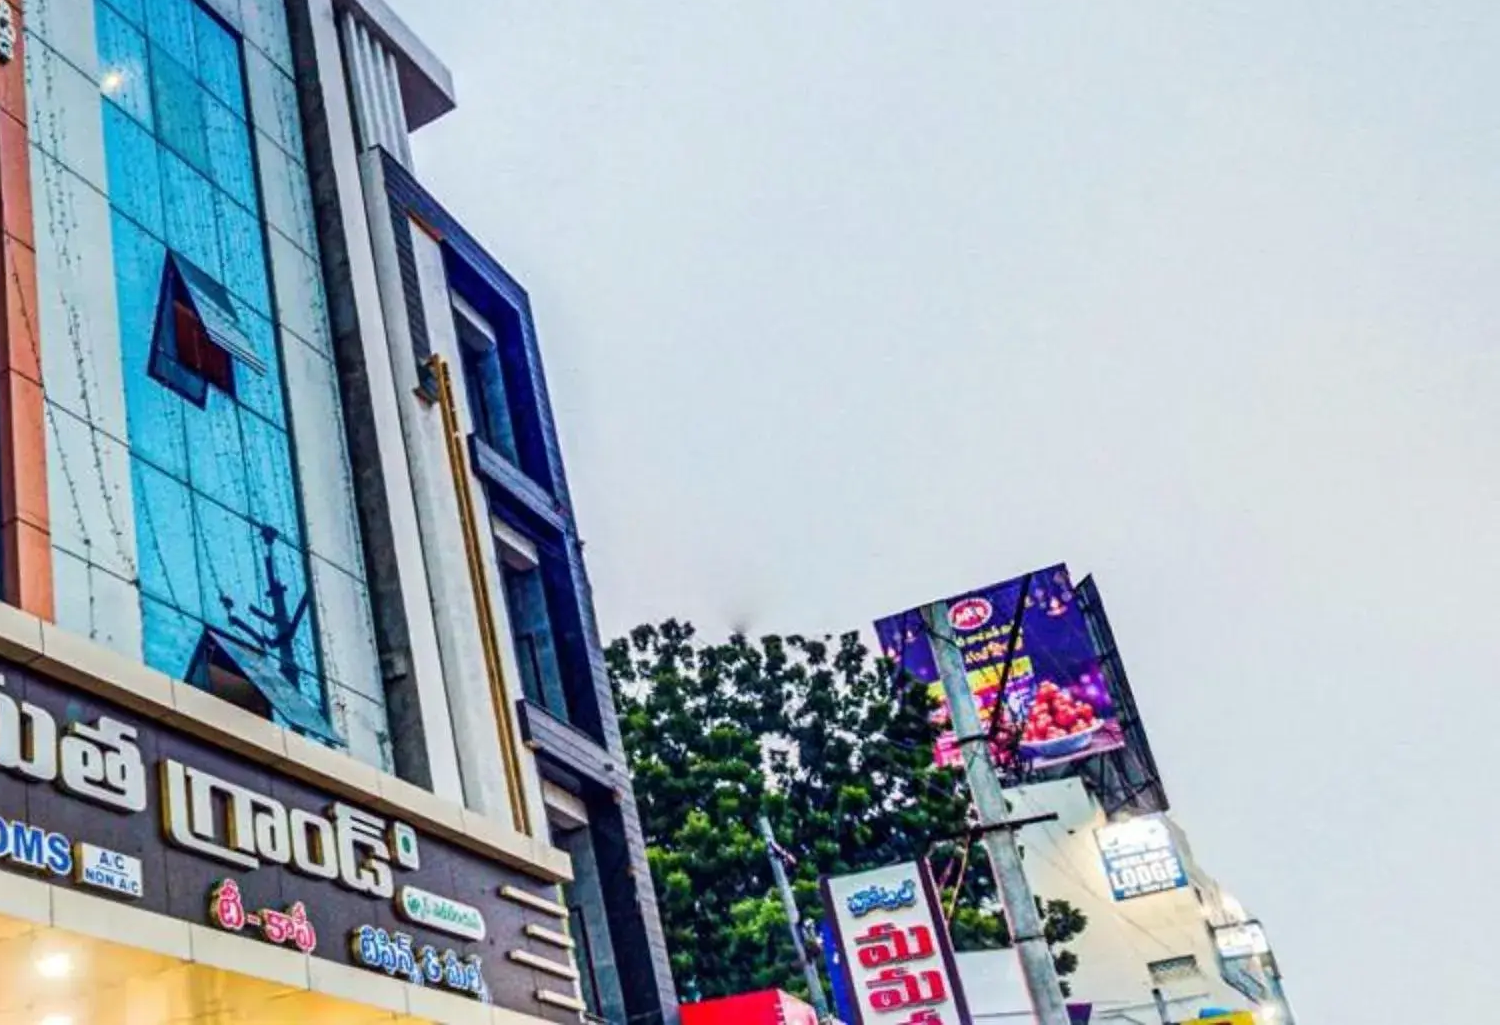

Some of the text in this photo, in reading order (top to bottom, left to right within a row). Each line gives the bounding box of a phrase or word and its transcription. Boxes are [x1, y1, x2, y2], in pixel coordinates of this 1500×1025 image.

[163, 758, 394, 899] గ్రాండ్
[85, 867, 116, 888] NON
[1109, 857, 1181, 890] LODGE
